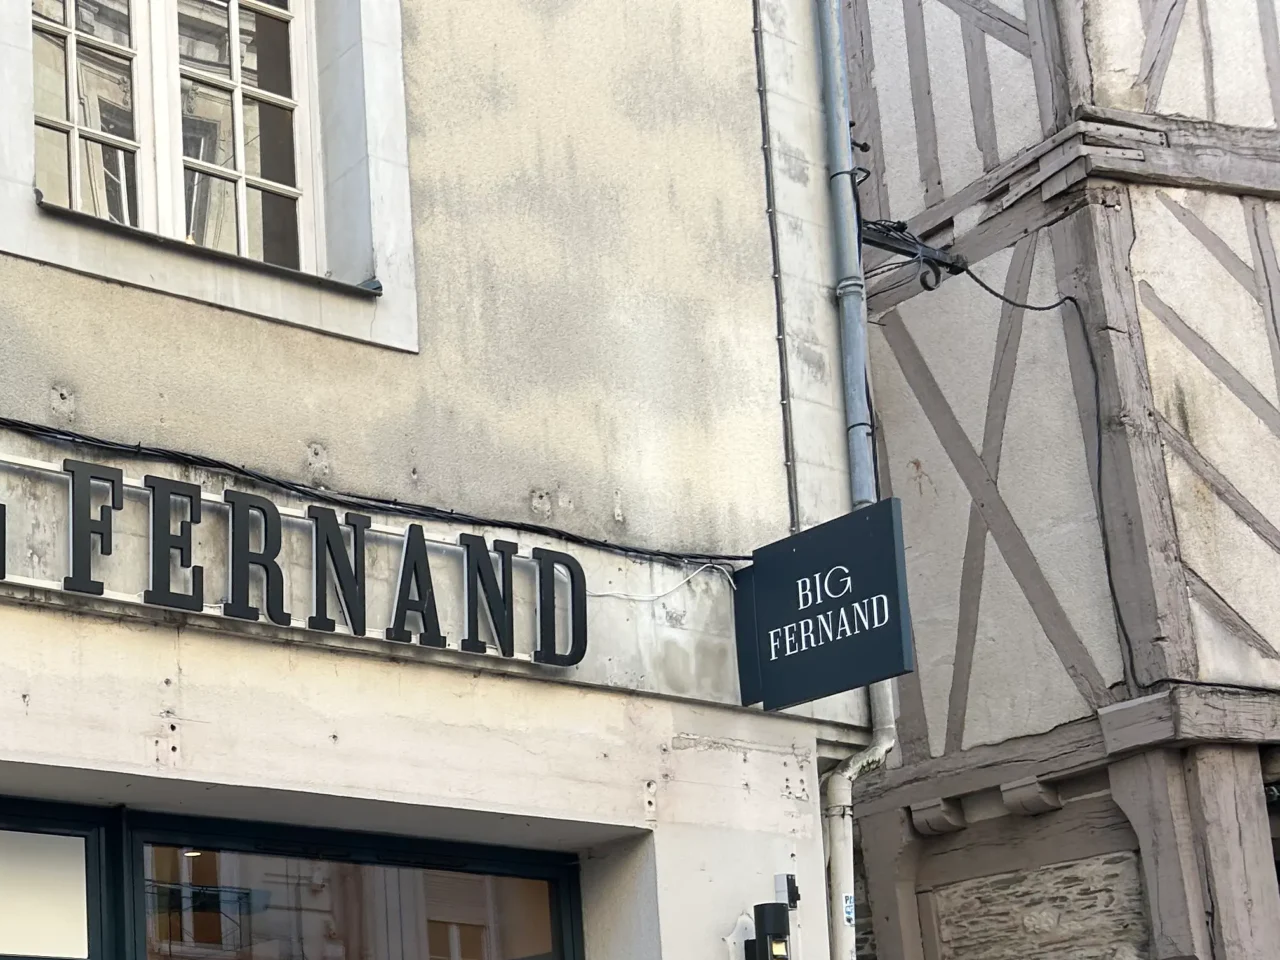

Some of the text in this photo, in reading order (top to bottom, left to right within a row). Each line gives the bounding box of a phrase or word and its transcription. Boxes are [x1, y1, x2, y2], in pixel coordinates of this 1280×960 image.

[61, 458, 589, 668] FERNAND
[796, 565, 852, 611] BIG
[768, 594, 889, 662] FERNAND
